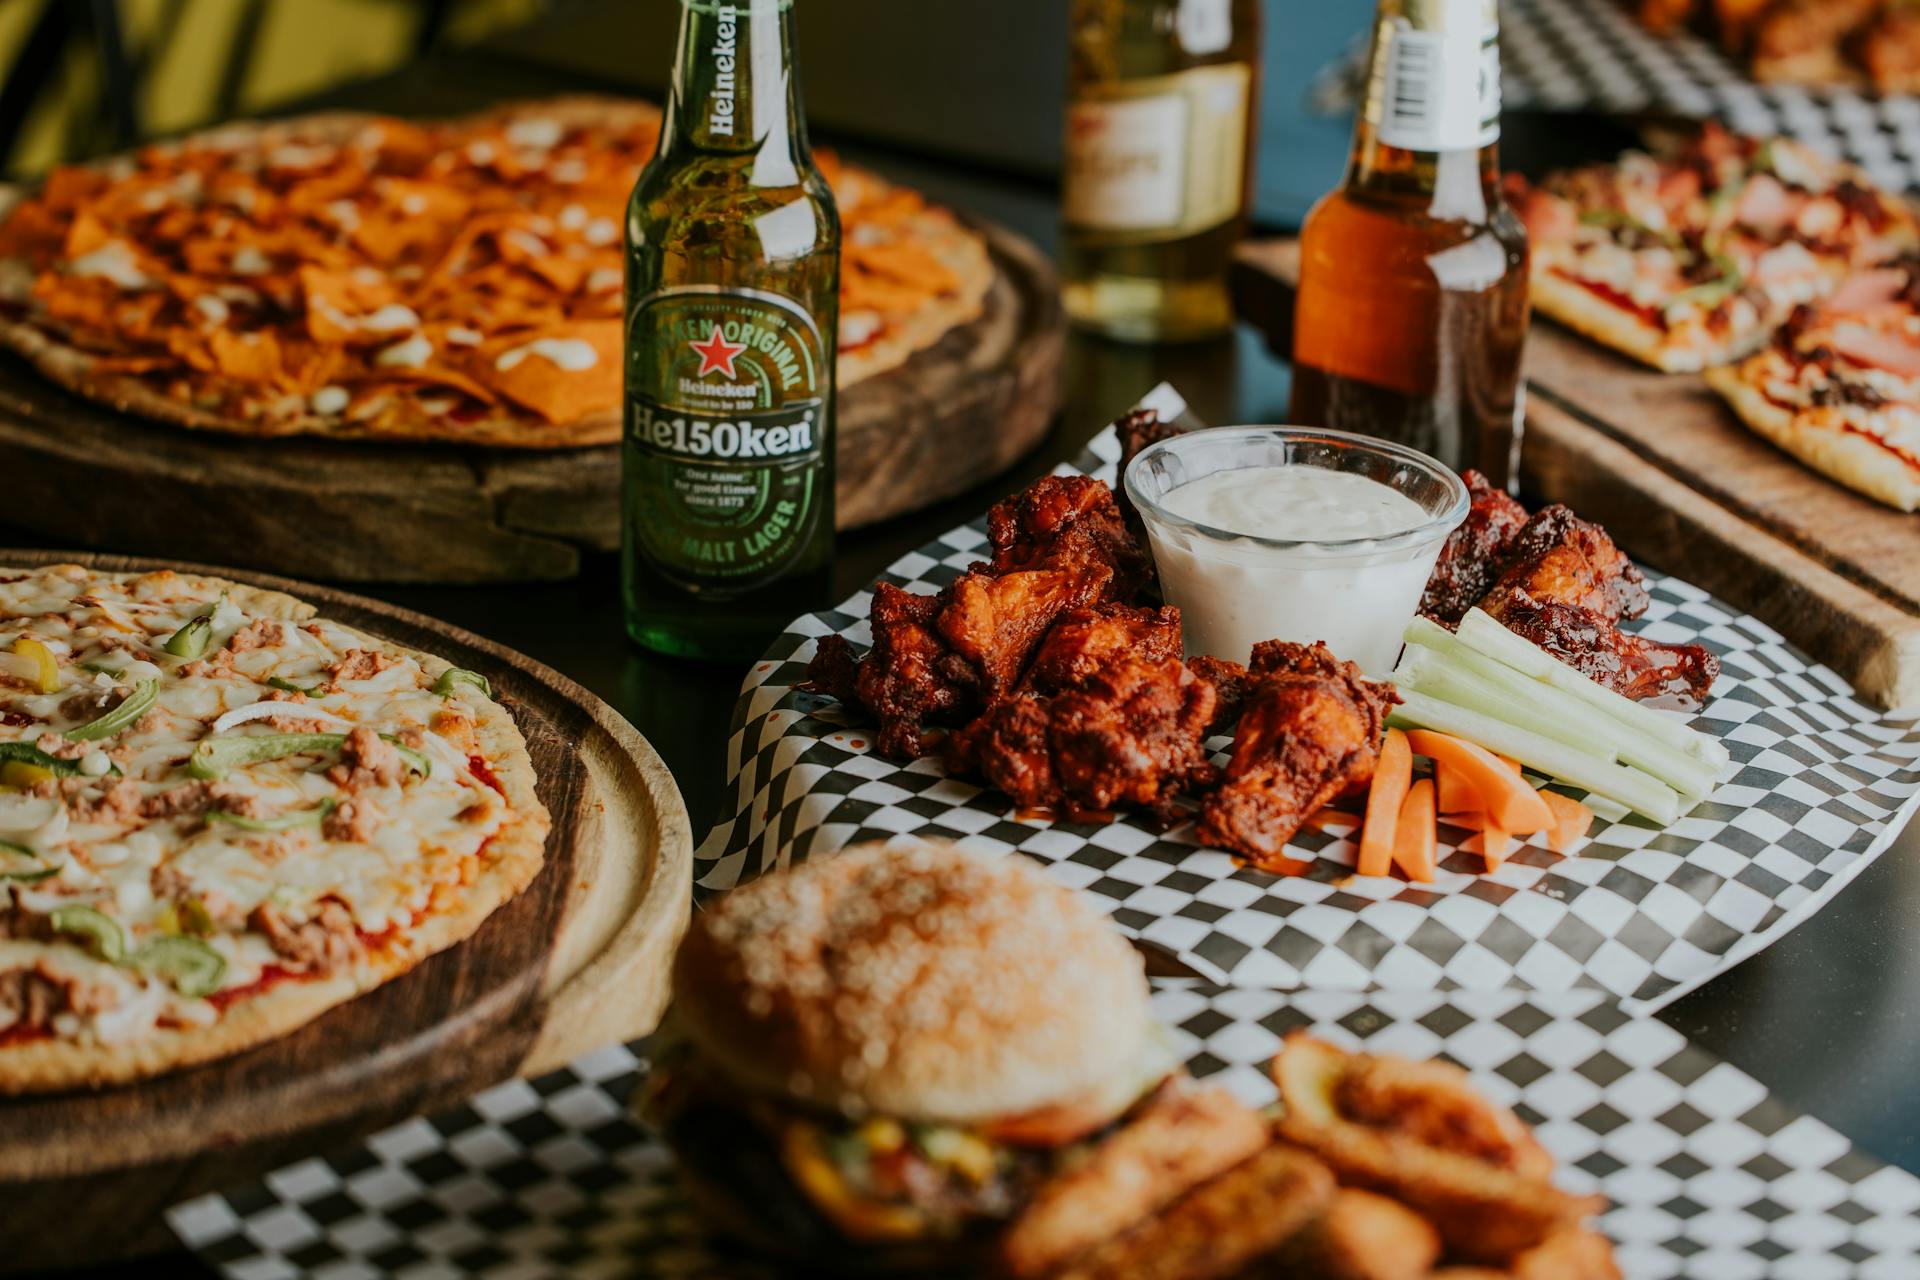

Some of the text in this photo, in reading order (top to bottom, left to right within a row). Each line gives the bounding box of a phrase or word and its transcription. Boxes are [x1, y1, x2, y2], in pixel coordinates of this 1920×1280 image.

[710, 5, 737, 136] Heineken
[724, 320, 802, 392] ORIGINAL
[679, 378, 757, 398] Heineken
[632, 403, 814, 458] He150ken
[684, 494, 745, 508] since 1873
[692, 482, 721, 495] good
[722, 483, 757, 495] times
[682, 537, 736, 563] MALT
[743, 499, 797, 557] LAGER
